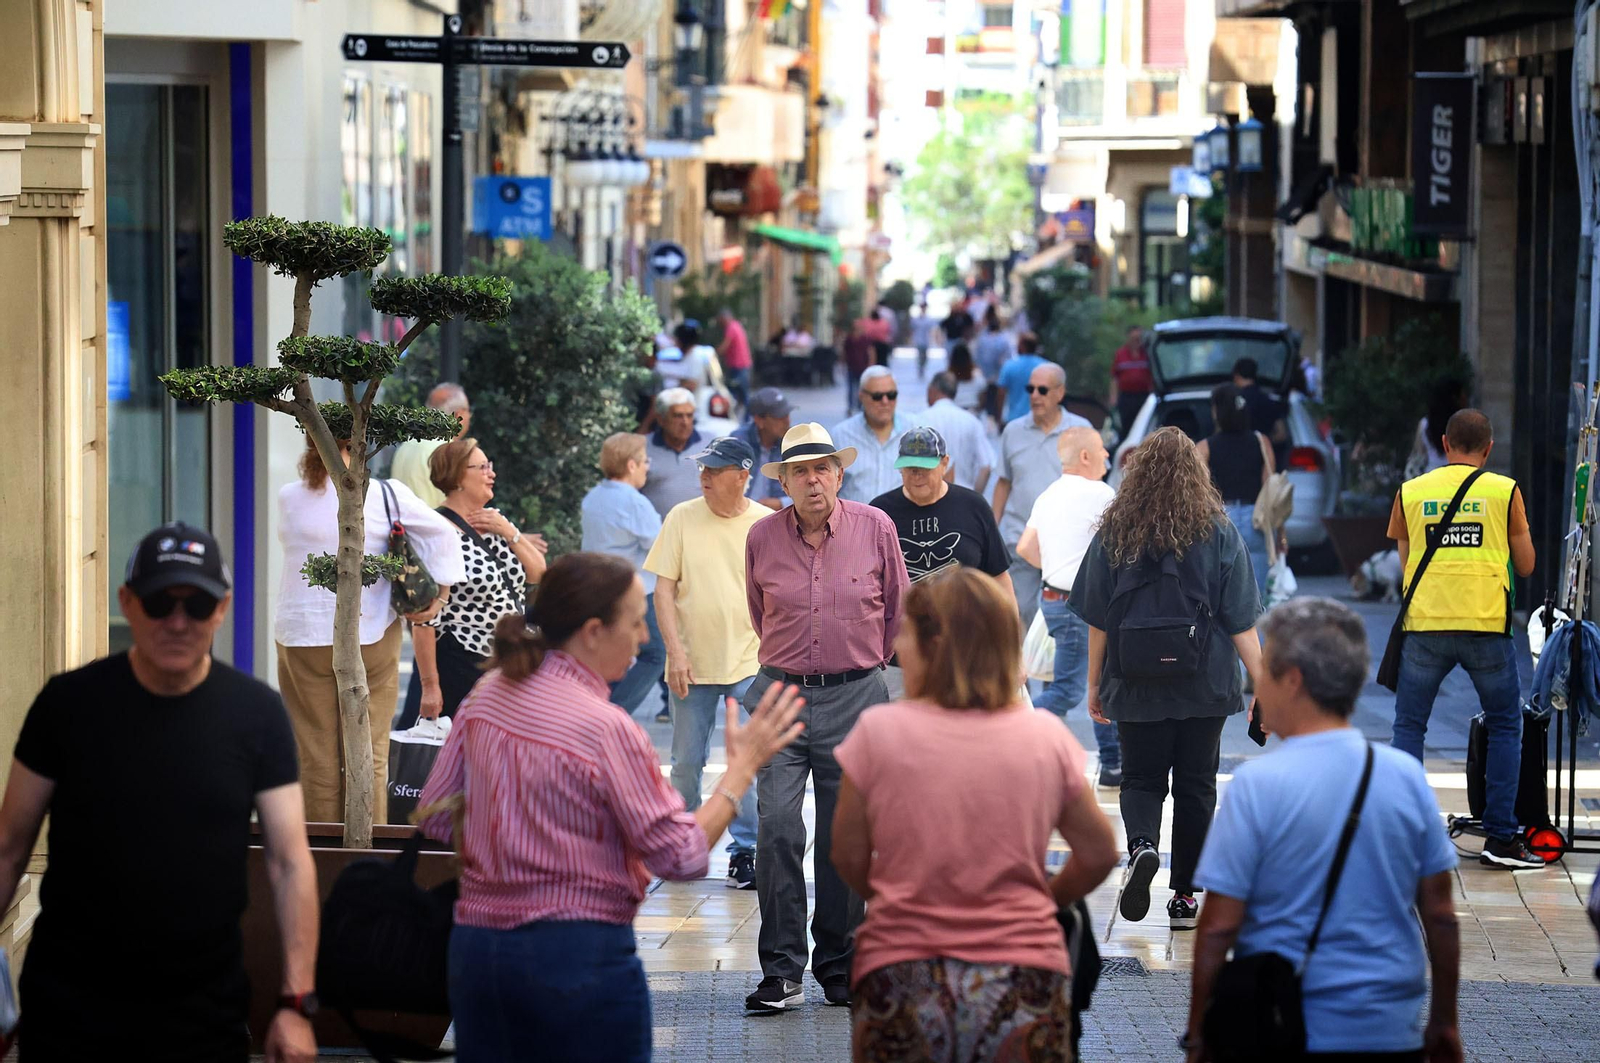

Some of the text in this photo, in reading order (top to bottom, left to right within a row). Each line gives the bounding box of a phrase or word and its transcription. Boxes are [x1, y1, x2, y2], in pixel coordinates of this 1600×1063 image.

[1430, 103, 1453, 206] TIGER
[1440, 502, 1481, 513] OCE
[912, 516, 940, 536] ETER
[1460, 524, 1480, 532] social
[1441, 532, 1480, 546] ONCE
